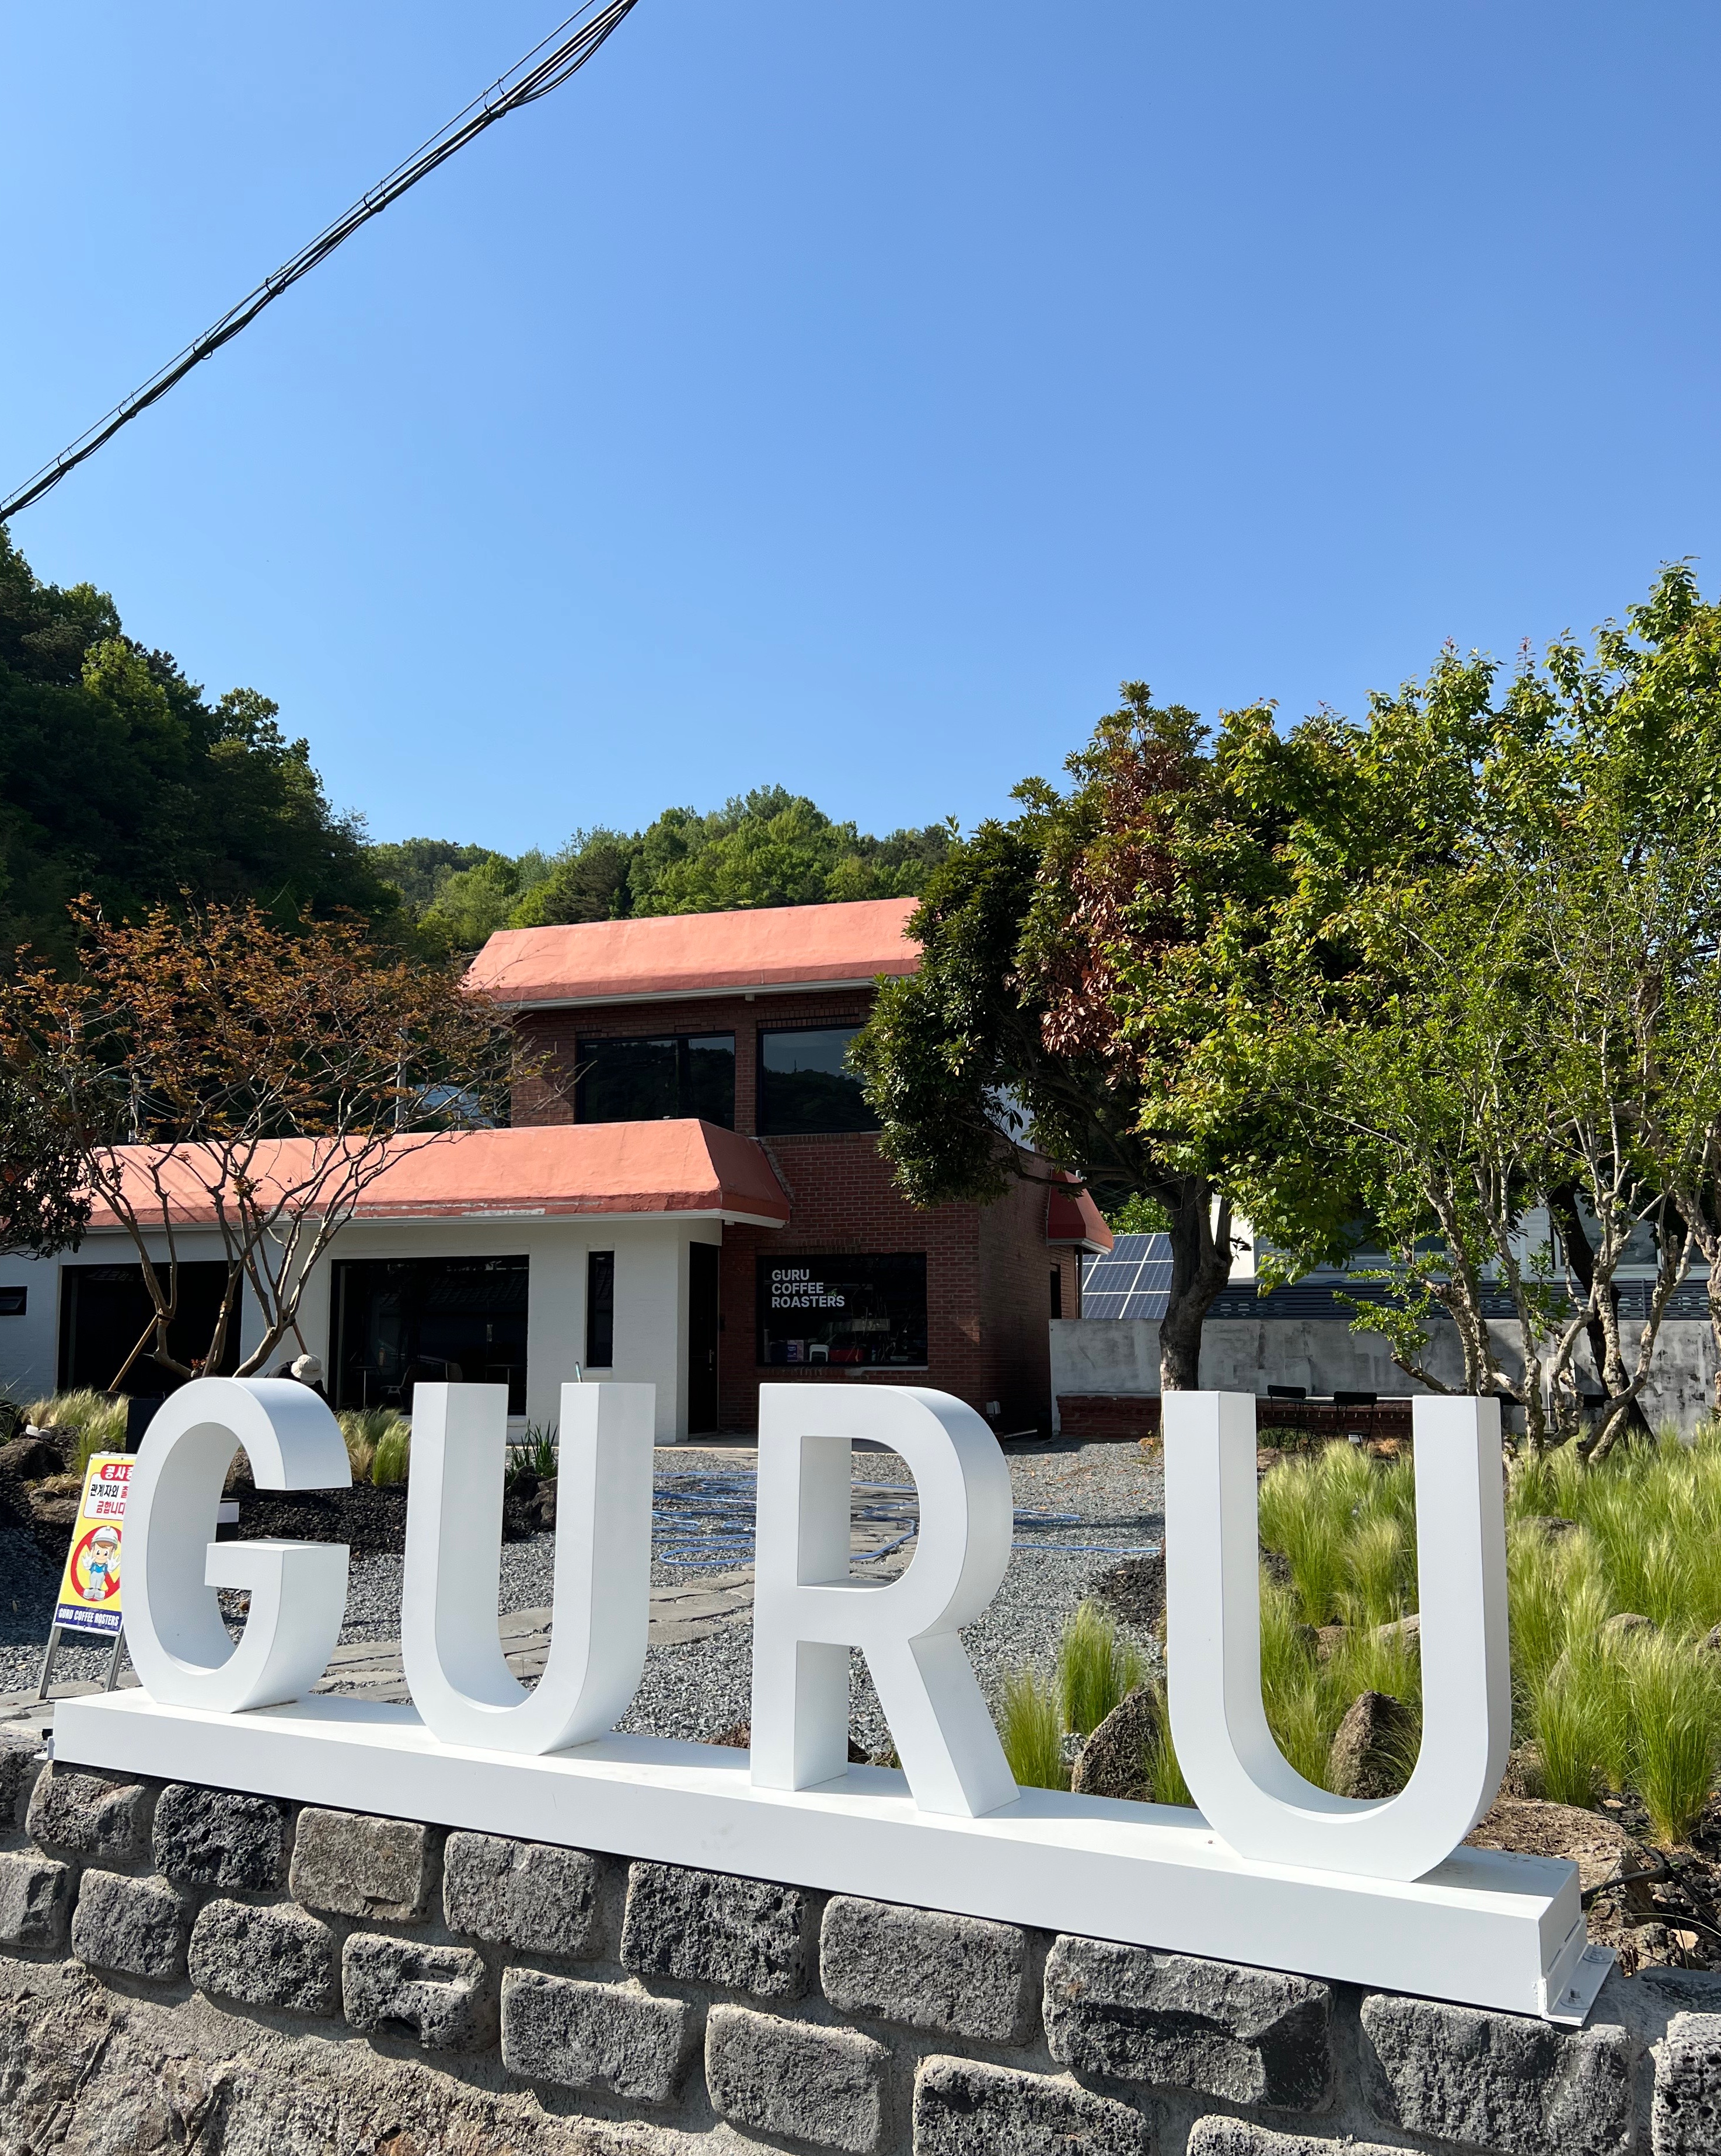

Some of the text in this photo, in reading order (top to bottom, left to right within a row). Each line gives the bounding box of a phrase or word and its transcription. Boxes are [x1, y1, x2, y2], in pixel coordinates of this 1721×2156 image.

[772, 1269, 809, 1281] GURU
[772, 1283, 824, 1294] COFFEE
[772, 1295, 845, 1308] ROASTERS
[90, 1484, 120, 1498] 관계자외
[58, 1608, 120, 1627] GURU COFFEE ROSTERS
[128, 1377, 1511, 1882] GURU
